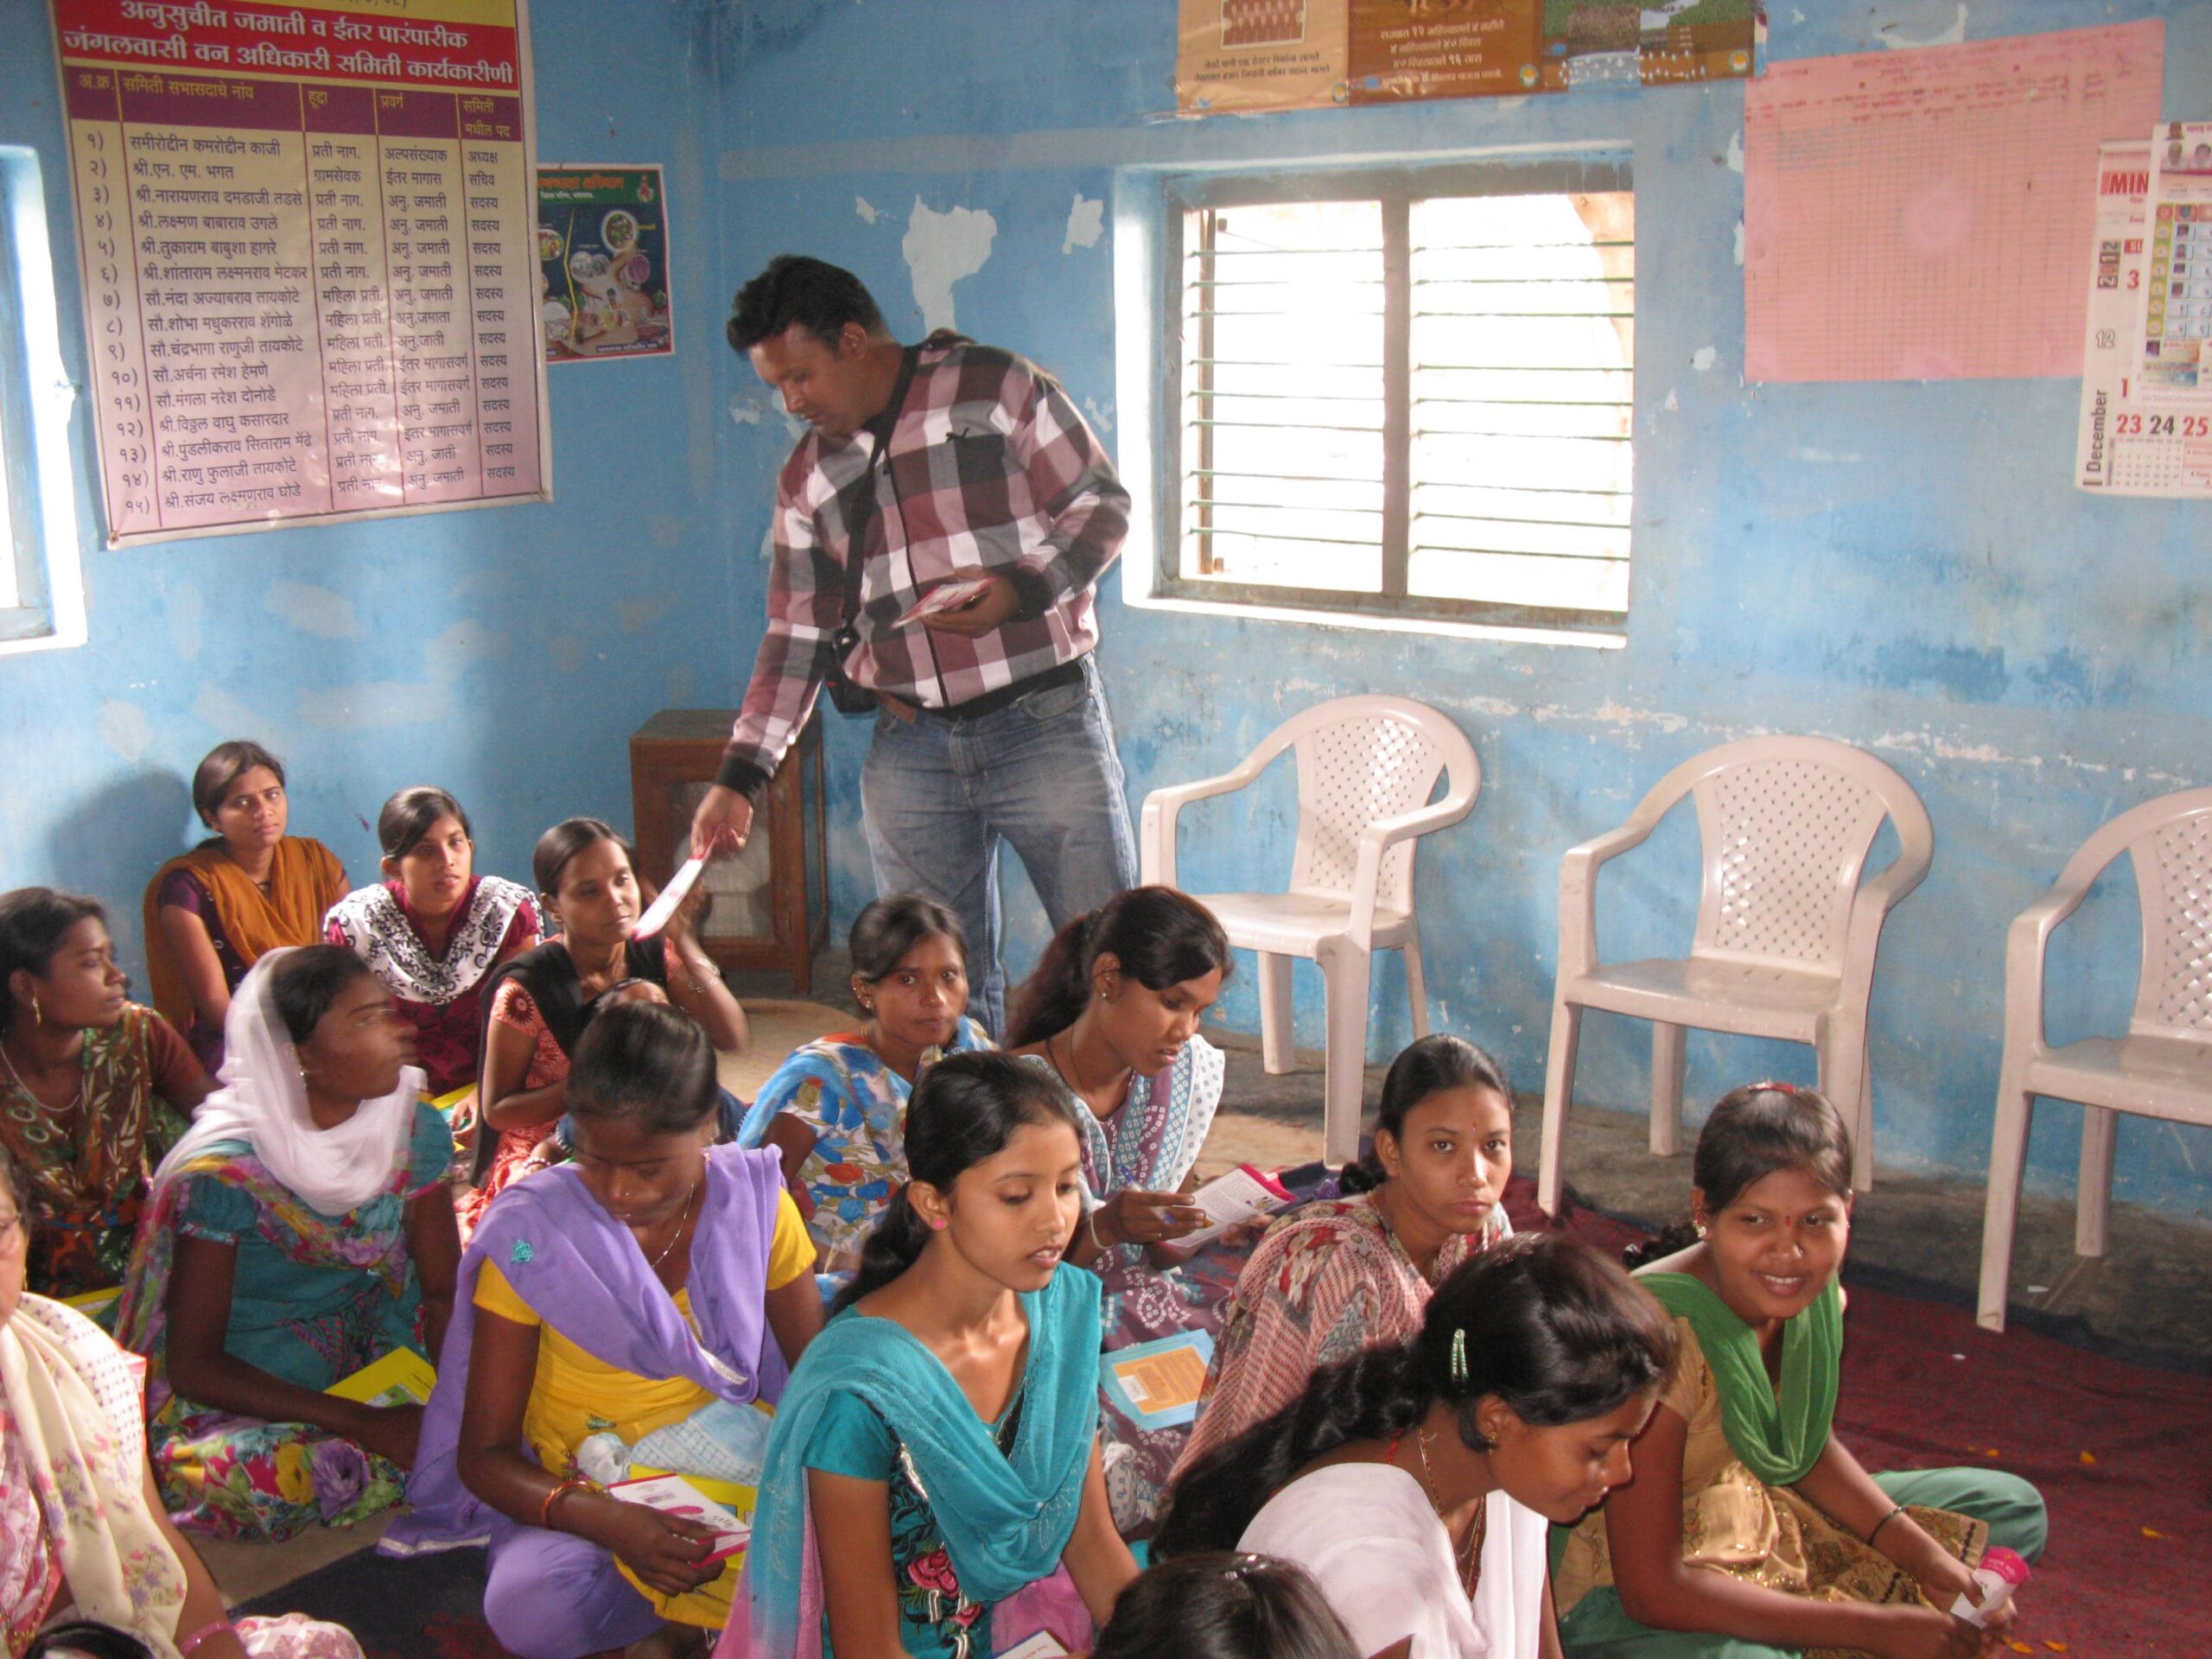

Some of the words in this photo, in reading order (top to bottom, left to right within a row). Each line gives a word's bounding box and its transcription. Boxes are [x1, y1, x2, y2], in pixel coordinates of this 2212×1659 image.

[122, 0, 227, 31] अनुसुचीत
[234, 10, 306, 35] जमाती
[311, 19, 327, 37] व
[333, 16, 372, 41] ईतर
[378, 22, 468, 49] पारंपारीक
[62, 24, 188, 60] जंगलवासी
[194, 42, 231, 64] वन
[237, 41, 330, 71] अधिकारी
[335, 49, 402, 77] समिती
[406, 57, 514, 84] कार्यकारीणी
[124, 73, 164, 94] समिती
[380, 93, 404, 110] प्रवर्ग
[462, 97, 494, 114] समिती
[495, 124, 511, 137] पद
[251, 139, 281, 156] काजी
[312, 141, 333, 159] प्रती
[337, 145, 360, 159] नाग.
[468, 151, 498, 163] अध्यक्ष
[206, 164, 234, 179] भगत
[386, 168, 408, 186] ईतर
[411, 172, 442, 185] मागास
[469, 170, 494, 186] सचिव
[316, 189, 335, 207] प्रती
[340, 194, 364, 207] नाग.
[389, 195, 409, 212] अनु.
[414, 193, 446, 208] जमाती
[470, 196, 499, 209] सदस्य
[318, 214, 337, 231] प्रती
[342, 218, 365, 231] नाग.
[391, 219, 411, 235] अनु.
[416, 216, 448, 232] जमाती
[472, 219, 499, 232] सदस्य
[320, 238, 340, 254] प्रती
[343, 242, 367, 254] नाग.
[392, 243, 412, 258] अनु.
[417, 238, 449, 254] जमाती
[473, 242, 500, 254] सदस्य
[321, 262, 341, 279] प्रती
[346, 266, 369, 279] नाग.
[393, 266, 414, 283] अनु.
[419, 262, 451, 277] जमाती
[474, 265, 502, 276] सदस्य
[421, 285, 453, 300] जमाती
[476, 288, 503, 300] सदस्य
[477, 310, 505, 322] सदस्य
[478, 333, 505, 345] सदस्य
[480, 355, 507, 367] सदस्य
[212, 365, 237, 379] रमेश
[481, 378, 508, 390] सदस्य
[211, 388, 237, 404] नरेश
[332, 404, 352, 422] प्रती
[429, 399, 460, 415] जमाती
[483, 399, 510, 411] सदस्य
[484, 421, 511, 434] सदस्य
[2087, 390, 2107, 472] December
[2117, 414, 2142, 434] 23
[2150, 416, 2174, 435] 24
[2183, 416, 2209, 436] 25
[486, 443, 513, 456] सदस्य
[335, 450, 356, 467] प्रती
[486, 467, 515, 479] सदस्य
[339, 476, 359, 493] प्रती
[409, 473, 427, 490] अनु
